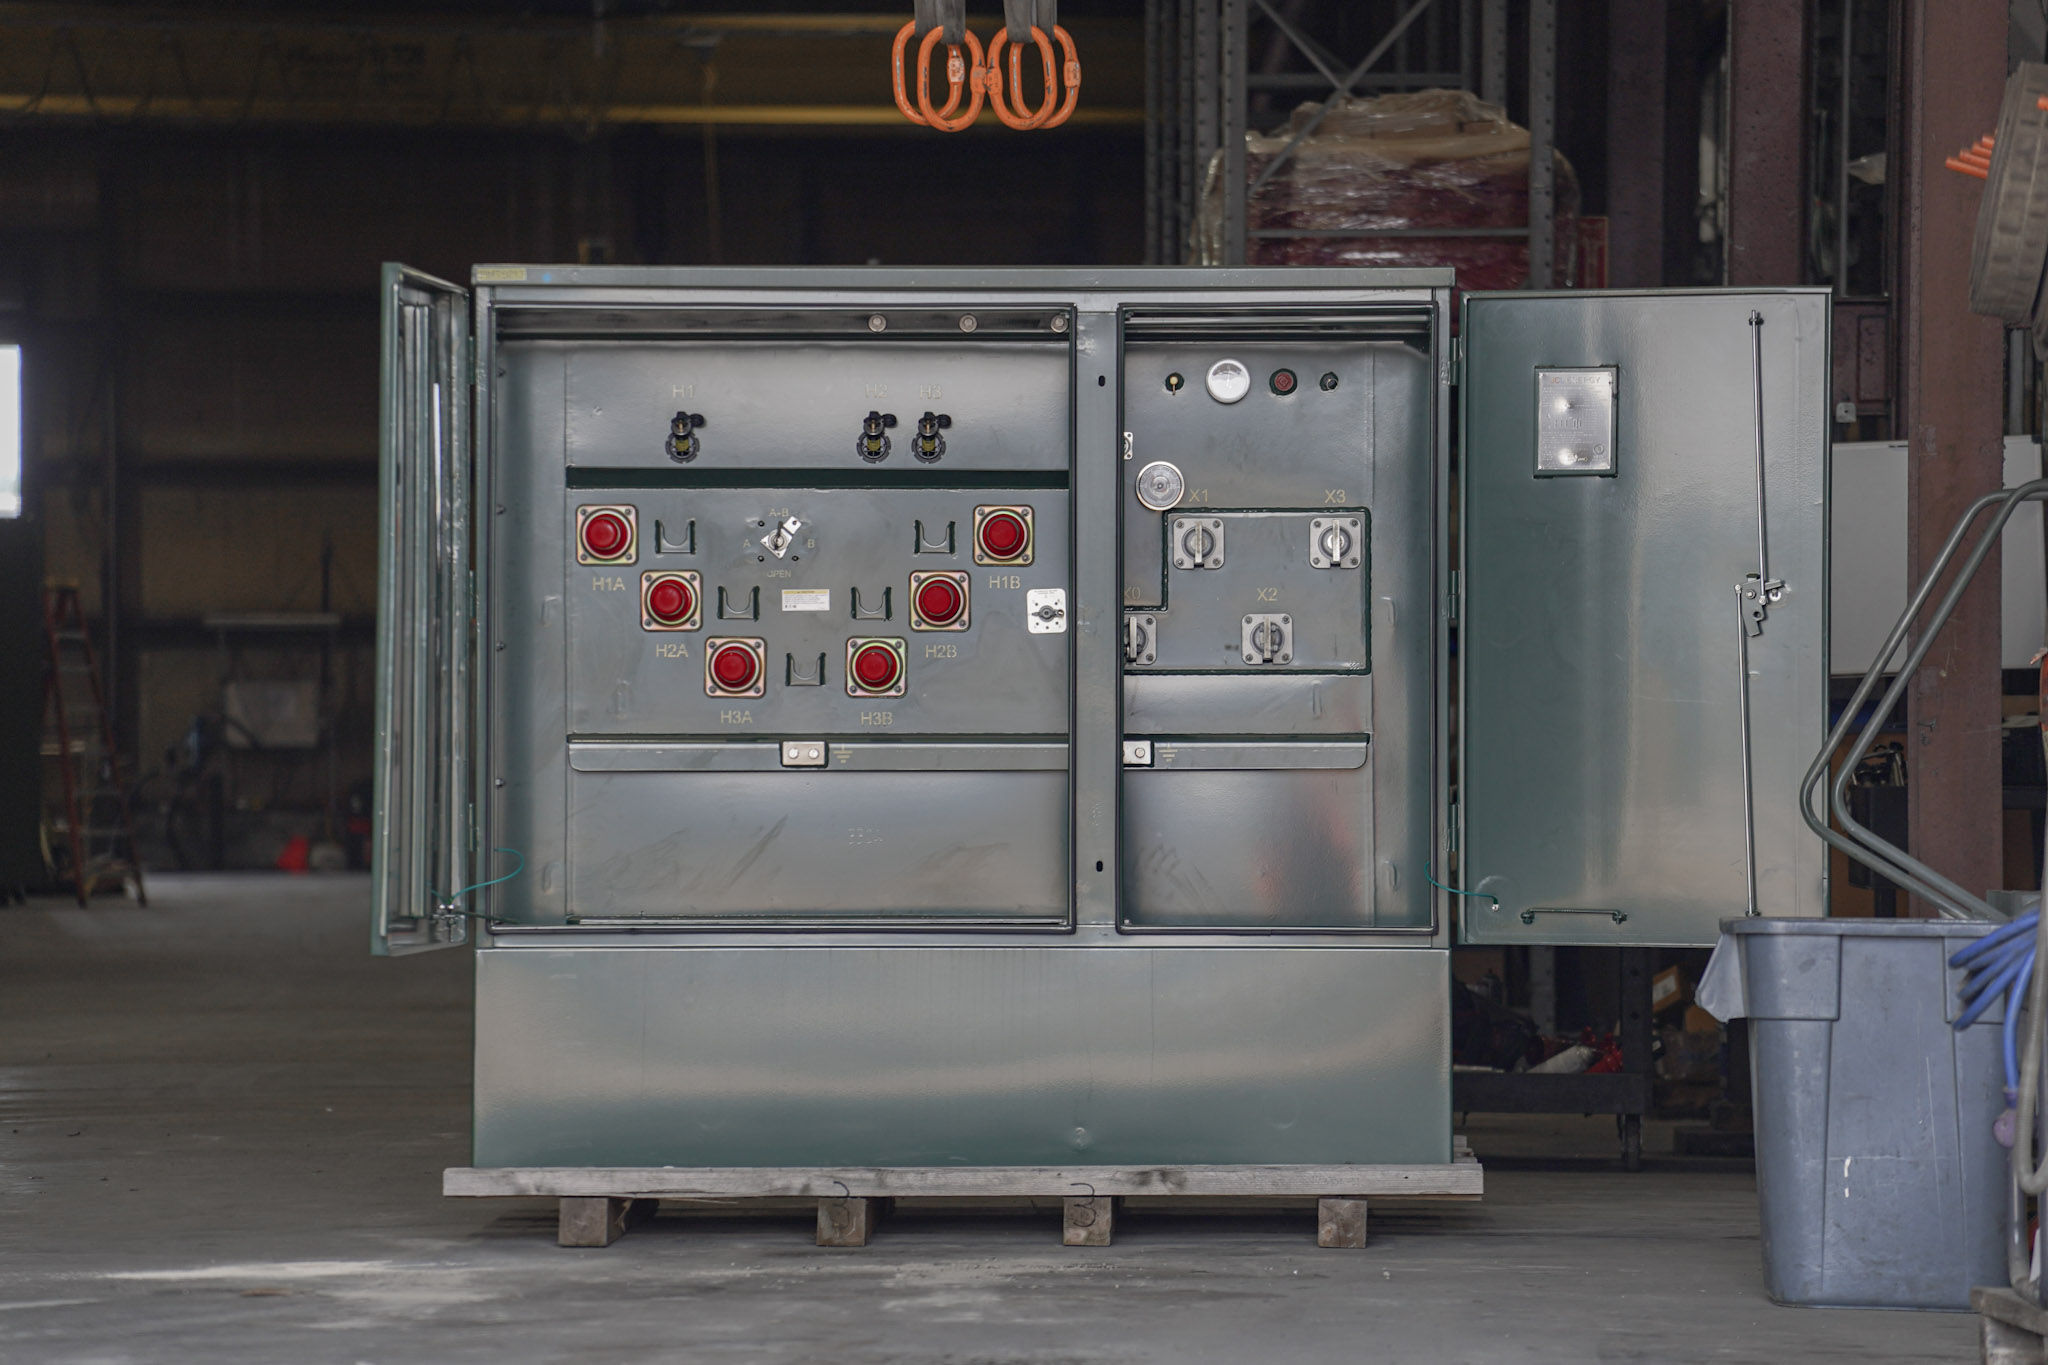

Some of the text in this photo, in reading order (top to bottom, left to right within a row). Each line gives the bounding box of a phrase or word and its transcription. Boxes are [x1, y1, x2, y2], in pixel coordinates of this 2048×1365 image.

[672, 384, 694, 399] H1
[919, 384, 942, 400] H3
[1188, 488, 1209, 502] X1
[1324, 489, 1347, 503] X3
[807, 539, 816, 549] B
[766, 569, 792, 578] OPEN
[592, 576, 626, 592] H1A
[988, 575, 1021, 589] H1B
[1256, 587, 1278, 601] X2
[655, 643, 689, 658] H2A
[925, 644, 957, 659] H2B
[720, 710, 753, 724] H3A
[860, 711, 893, 726] H3B
